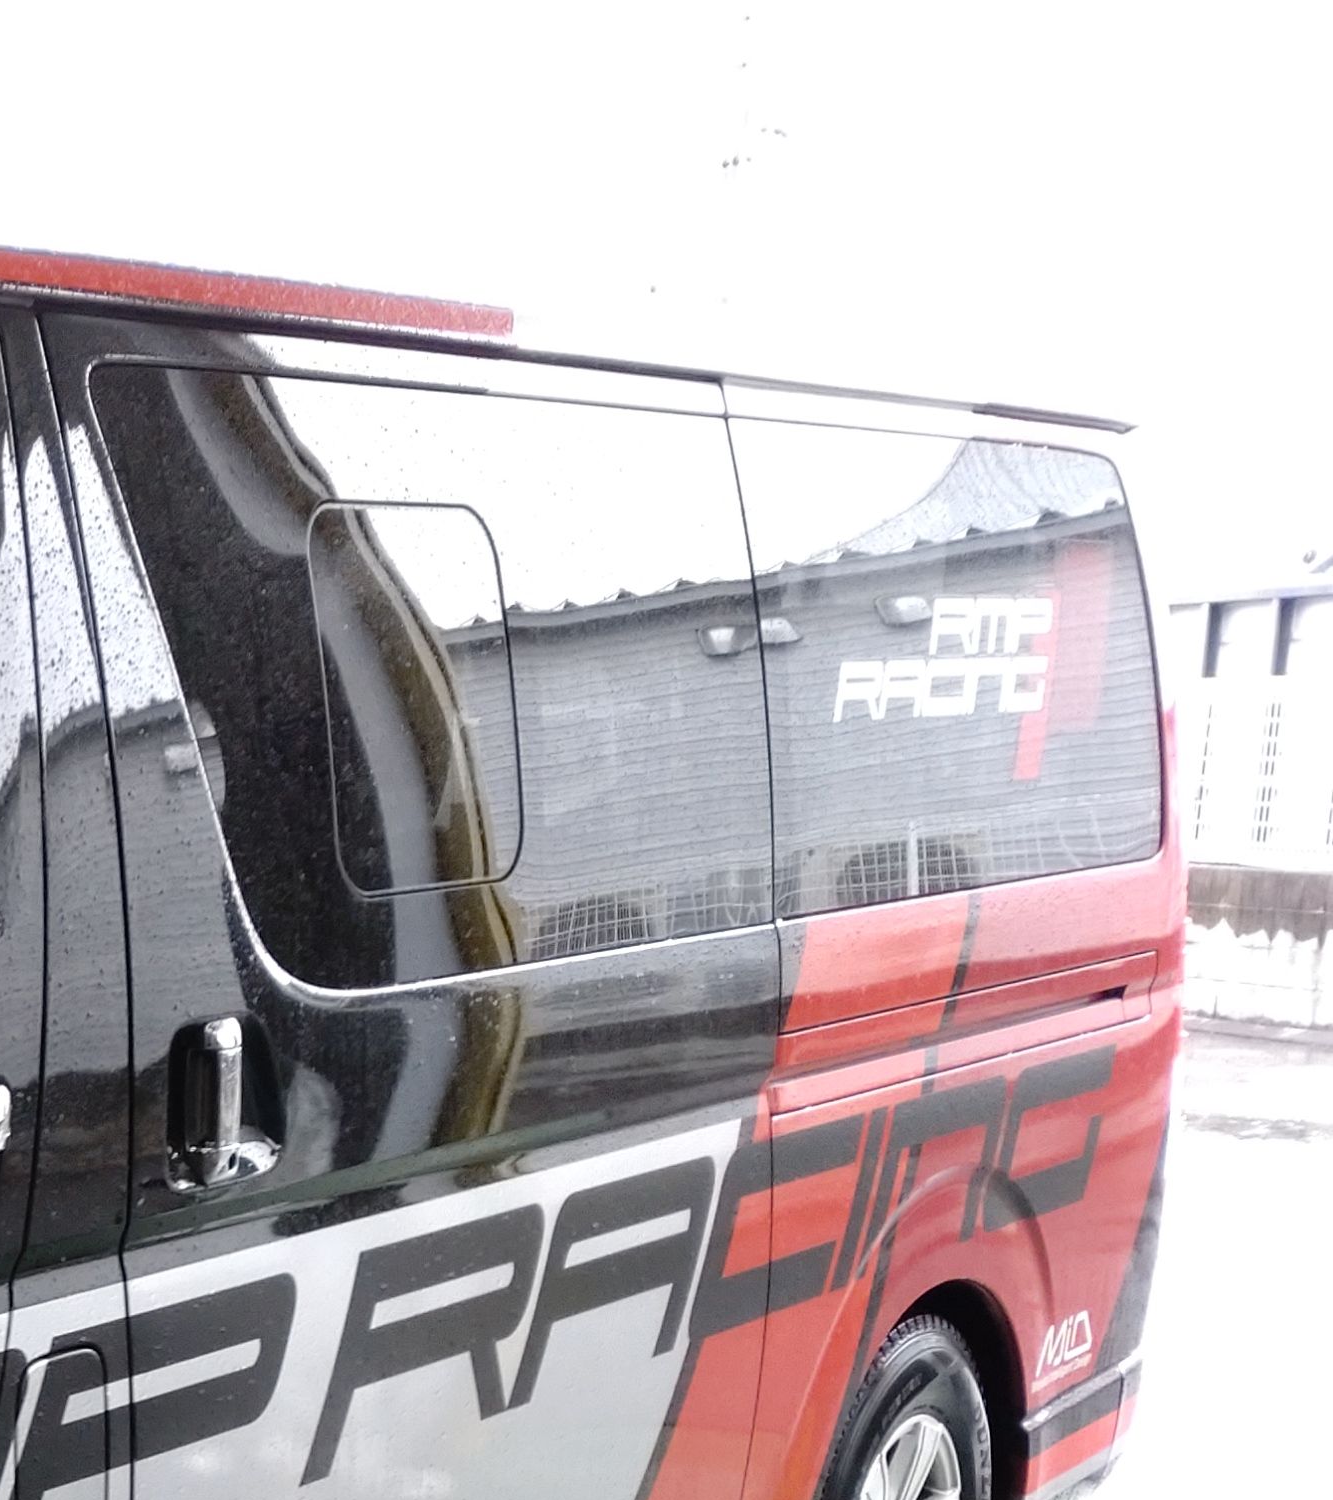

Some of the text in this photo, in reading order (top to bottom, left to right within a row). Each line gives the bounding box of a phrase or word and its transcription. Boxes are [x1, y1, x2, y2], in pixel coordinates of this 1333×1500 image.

[928, 595, 1054, 656] RMP
[833, 655, 1049, 723] RACING
[300, 1046, 1116, 1487] RACING
